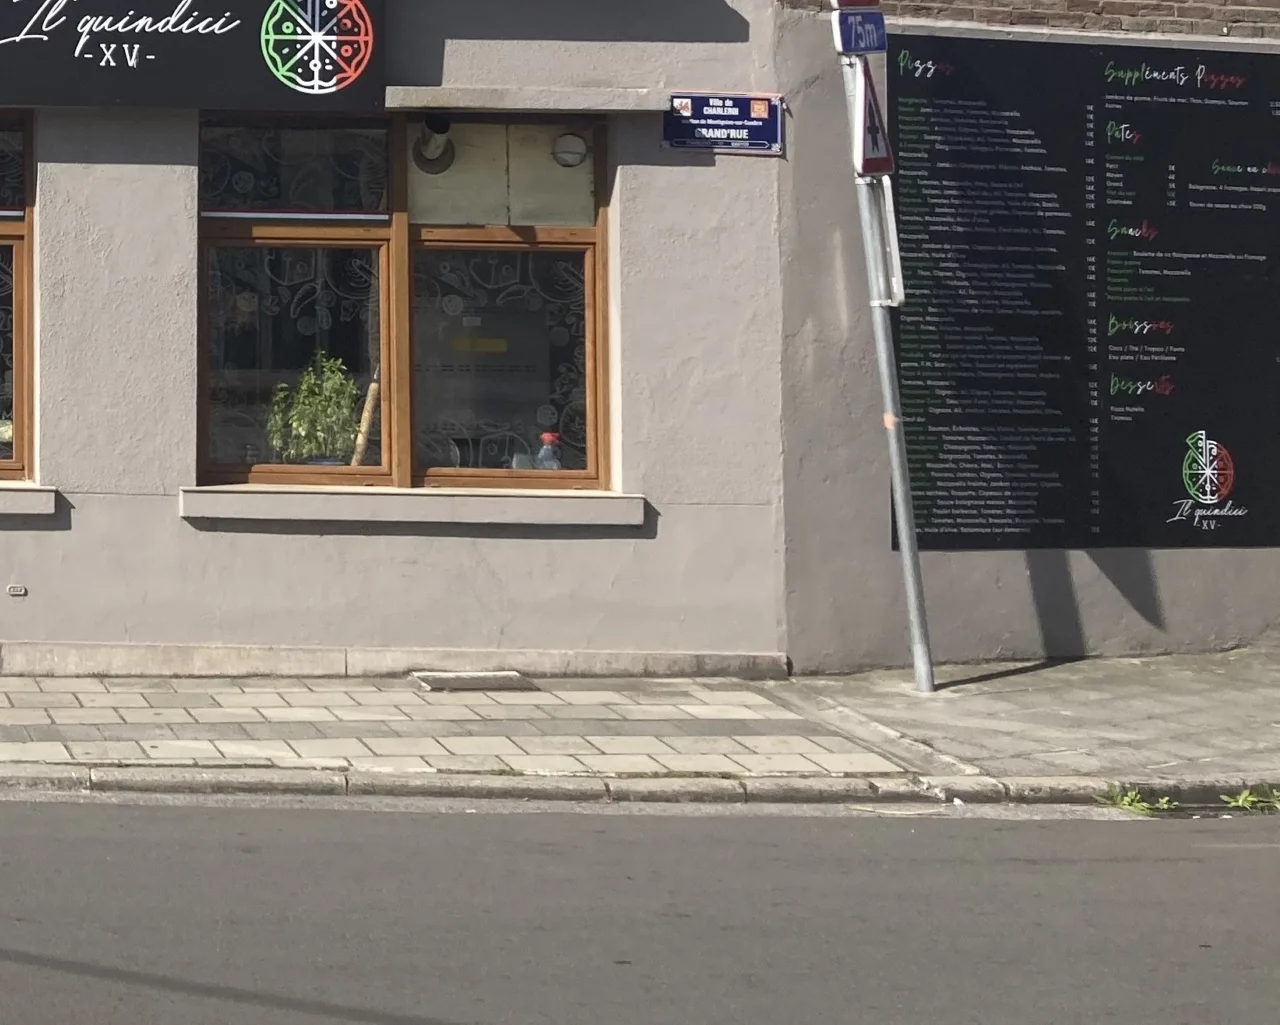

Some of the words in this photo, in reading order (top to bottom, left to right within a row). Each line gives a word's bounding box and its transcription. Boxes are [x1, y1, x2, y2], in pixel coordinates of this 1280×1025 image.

[848, 15, 878, 49] 75m
[695, 128, 748, 139] GRAND'RUE
[1166, 499, 1195, 523] Il
[1193, 500, 1248, 526] quindici
